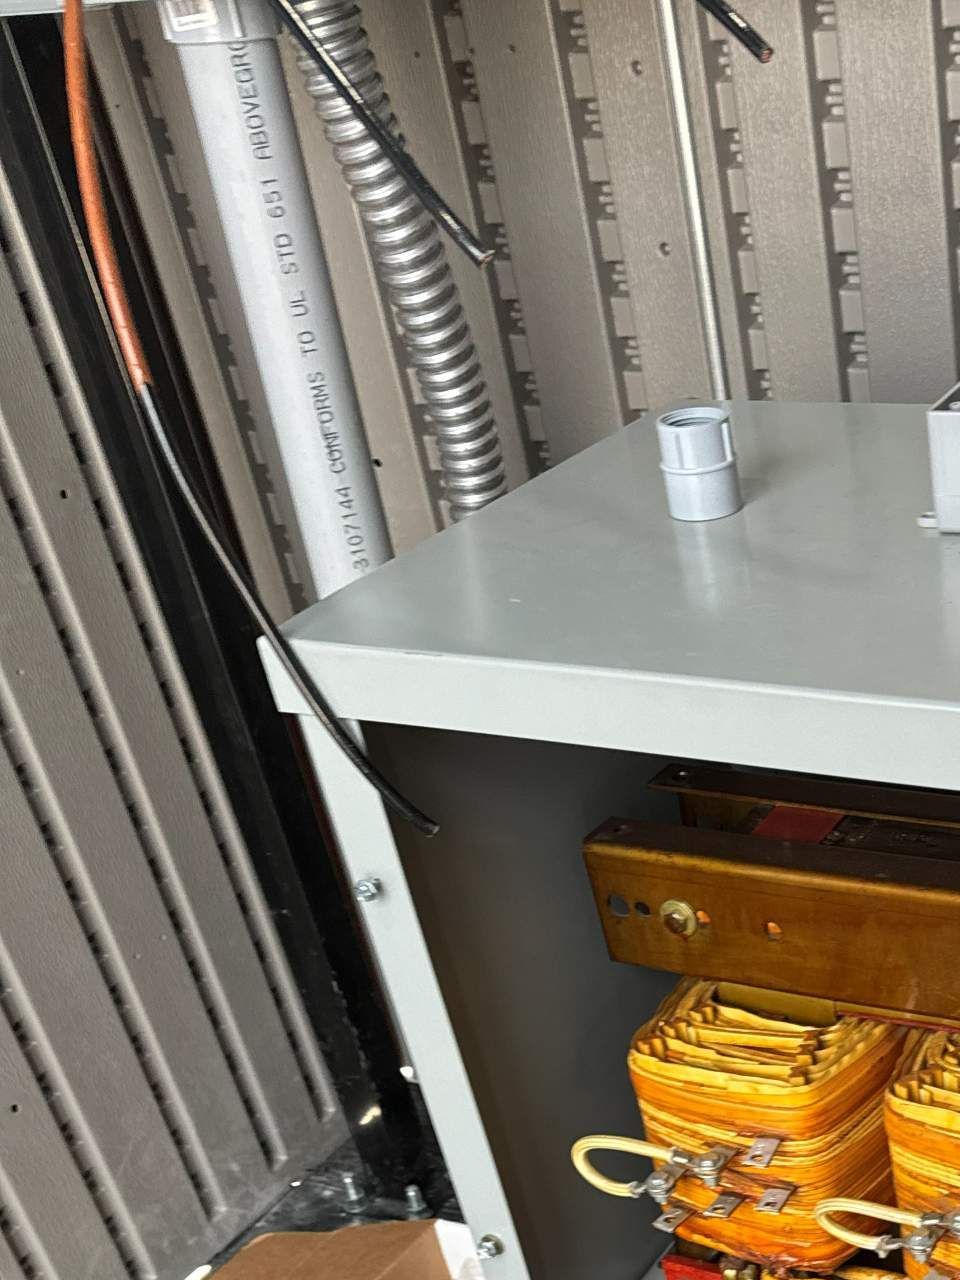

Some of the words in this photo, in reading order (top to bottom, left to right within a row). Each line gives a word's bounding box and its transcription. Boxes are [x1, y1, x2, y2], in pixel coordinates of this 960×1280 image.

[261, 178, 286, 218] 651
[274, 233, 300, 275] STD
[289, 289, 310, 317] UL
[296, 331, 318, 357] TO
[307, 370, 347, 474] CONFORMS
[335, 486, 370, 569] 3107144
